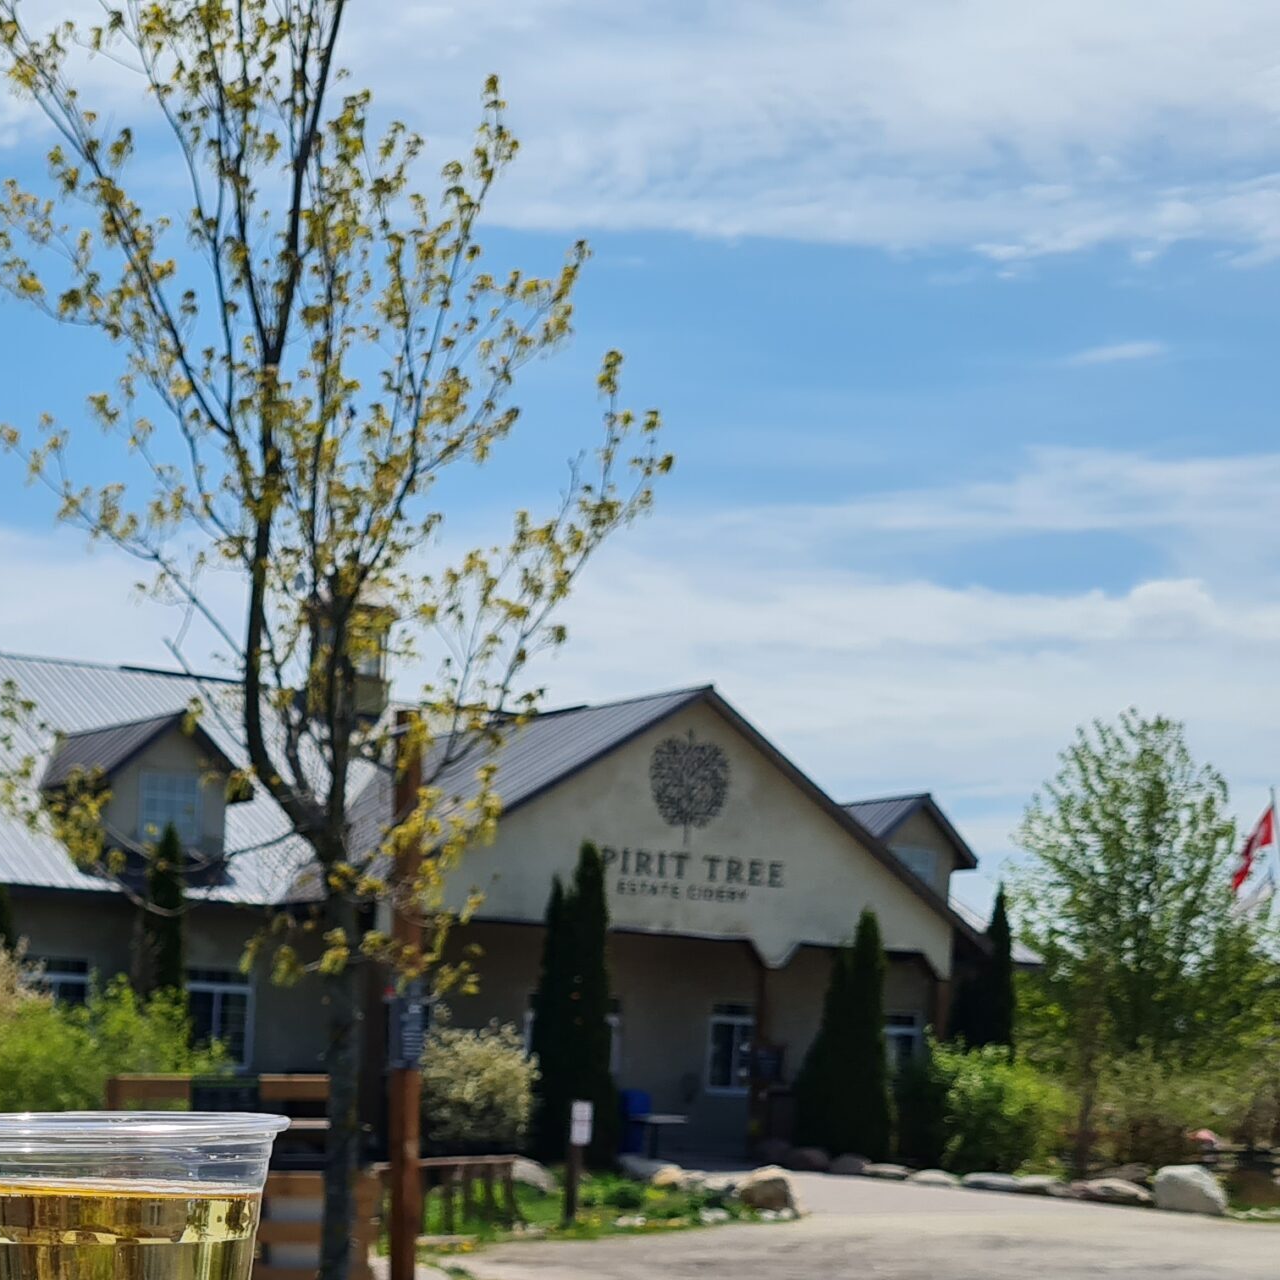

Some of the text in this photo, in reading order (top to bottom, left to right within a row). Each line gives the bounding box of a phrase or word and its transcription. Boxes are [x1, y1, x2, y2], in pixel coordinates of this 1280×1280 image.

[601, 847, 784, 888] PIRIT TREE
[617, 878, 749, 903] ESTATE CIDERY
